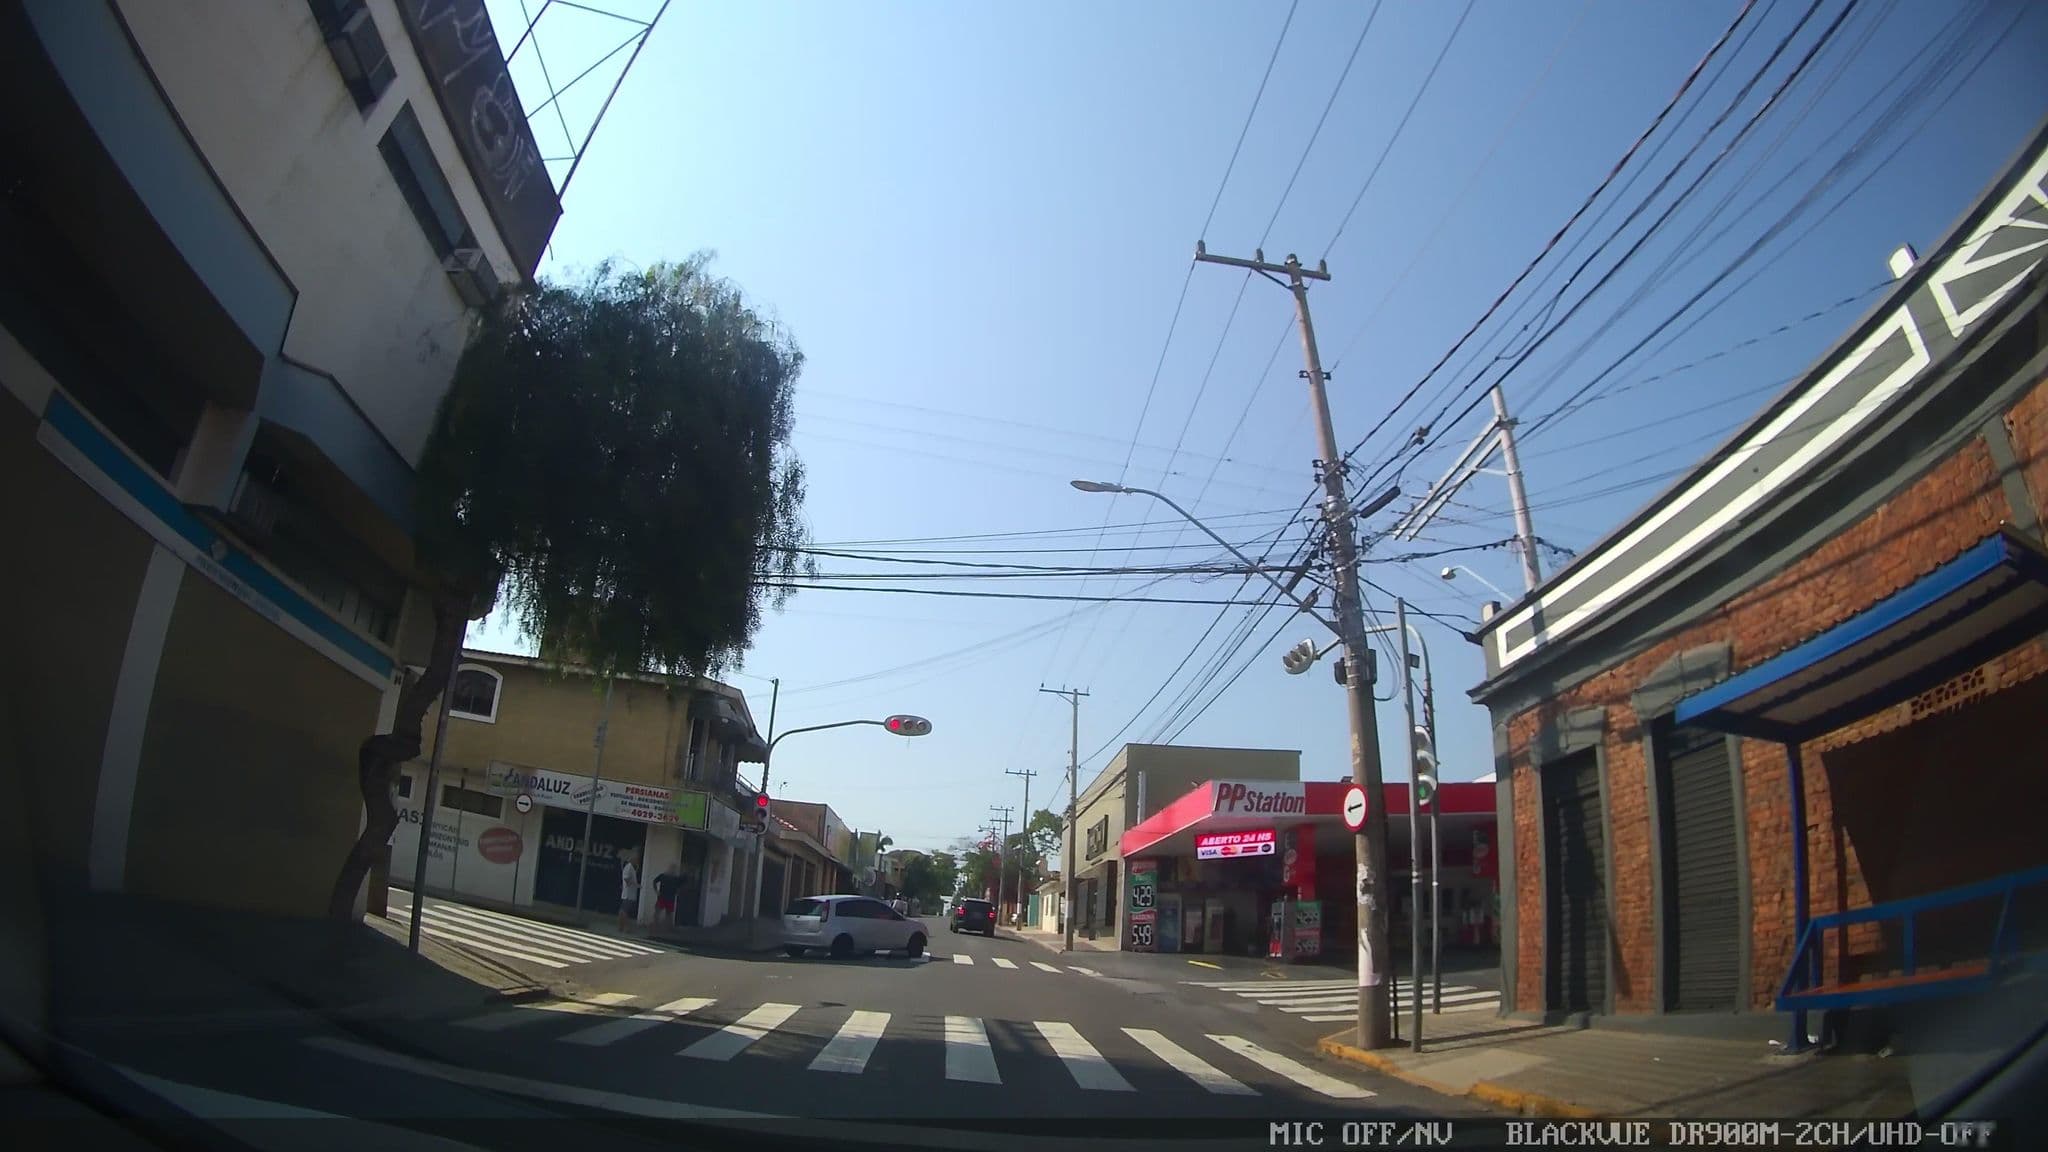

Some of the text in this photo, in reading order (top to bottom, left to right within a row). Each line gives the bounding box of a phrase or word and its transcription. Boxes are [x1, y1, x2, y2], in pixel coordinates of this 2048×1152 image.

[1214, 783, 1305, 813] PP Station
[1201, 834, 1241, 846] ABERTO
[1242, 833, 1258, 843] 24
